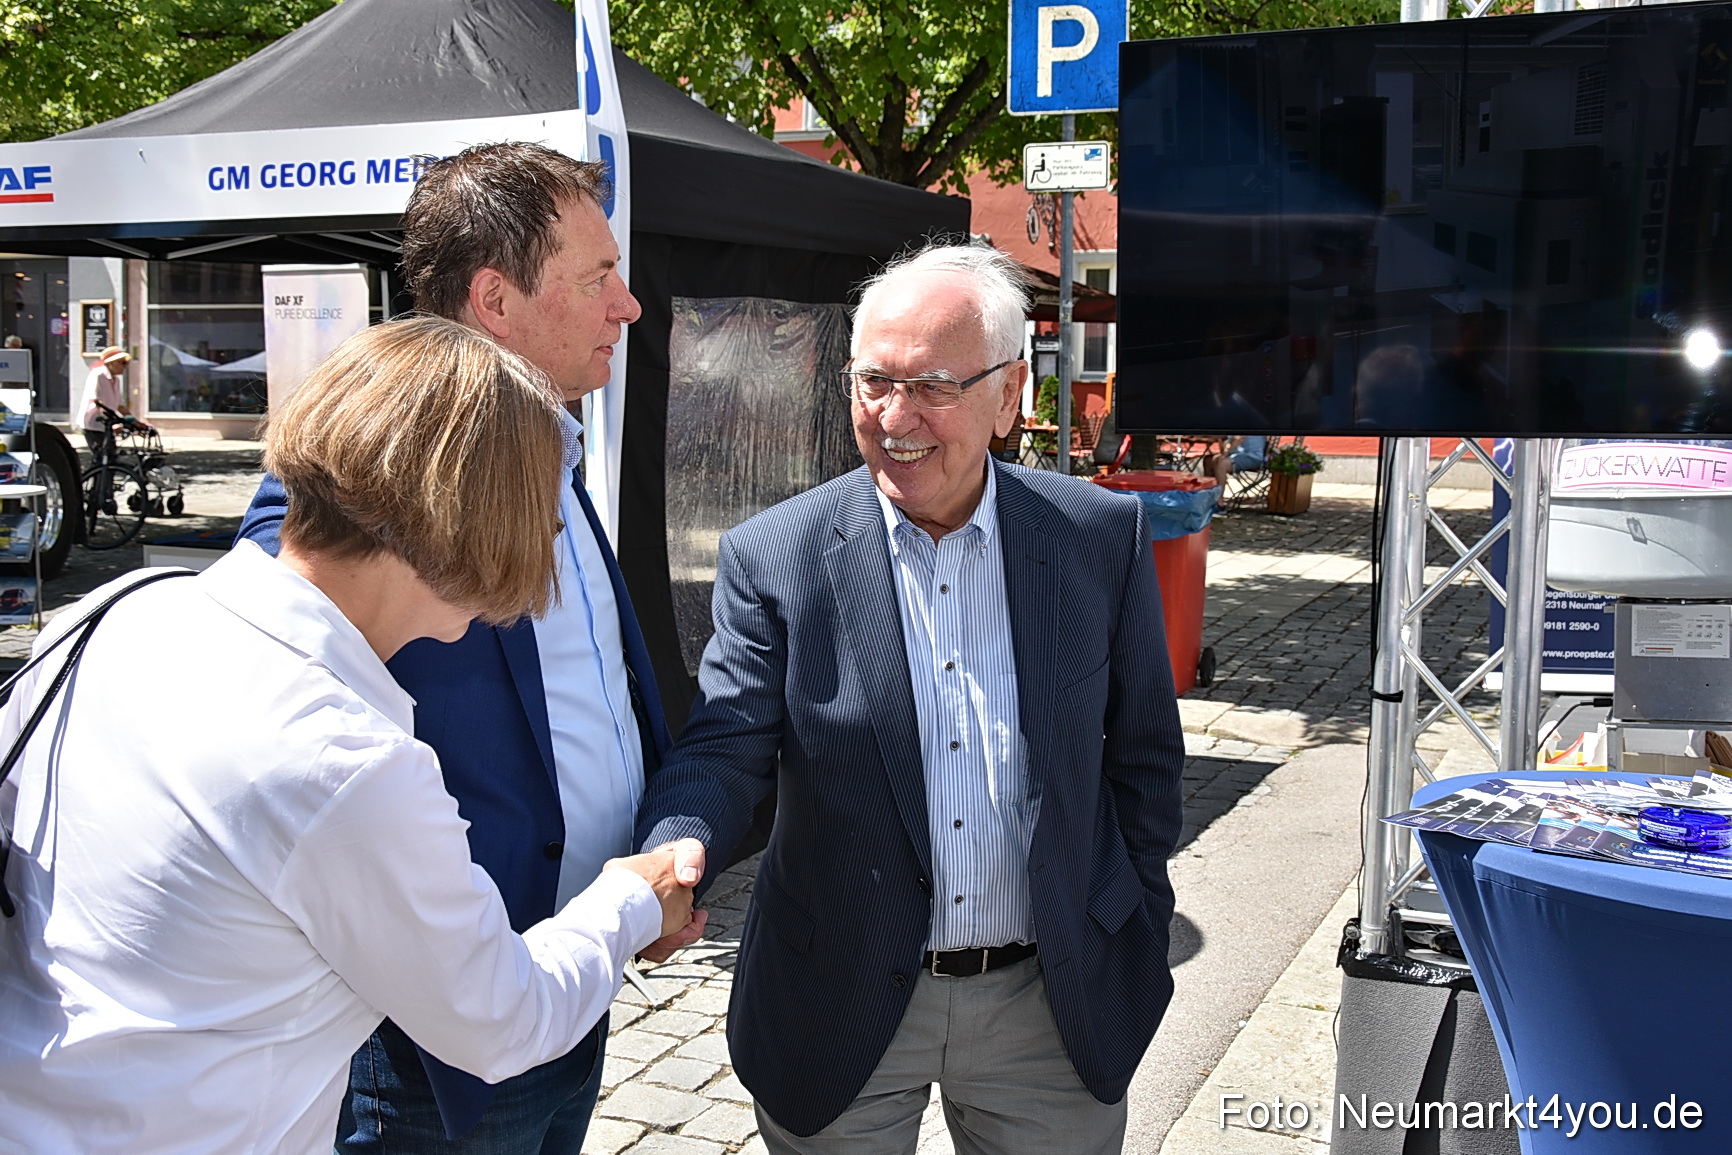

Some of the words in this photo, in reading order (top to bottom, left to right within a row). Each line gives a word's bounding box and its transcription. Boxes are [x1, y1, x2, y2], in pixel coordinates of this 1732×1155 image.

[1037, 5, 1099, 97] P
[208, 165, 250, 191] GM
[260, 160, 356, 189] GEORG
[366, 156, 447, 185] MEI
[274, 295, 291, 306] DAF
[293, 295, 304, 306] XF
[275, 307, 295, 320] PURE
[296, 307, 343, 320] EXCELLENCE
[1564, 455, 1727, 483] ZUCKERWATTE
[1545, 590, 1602, 600] egensburger
[1568, 621, 1600, 631] 2590-0
